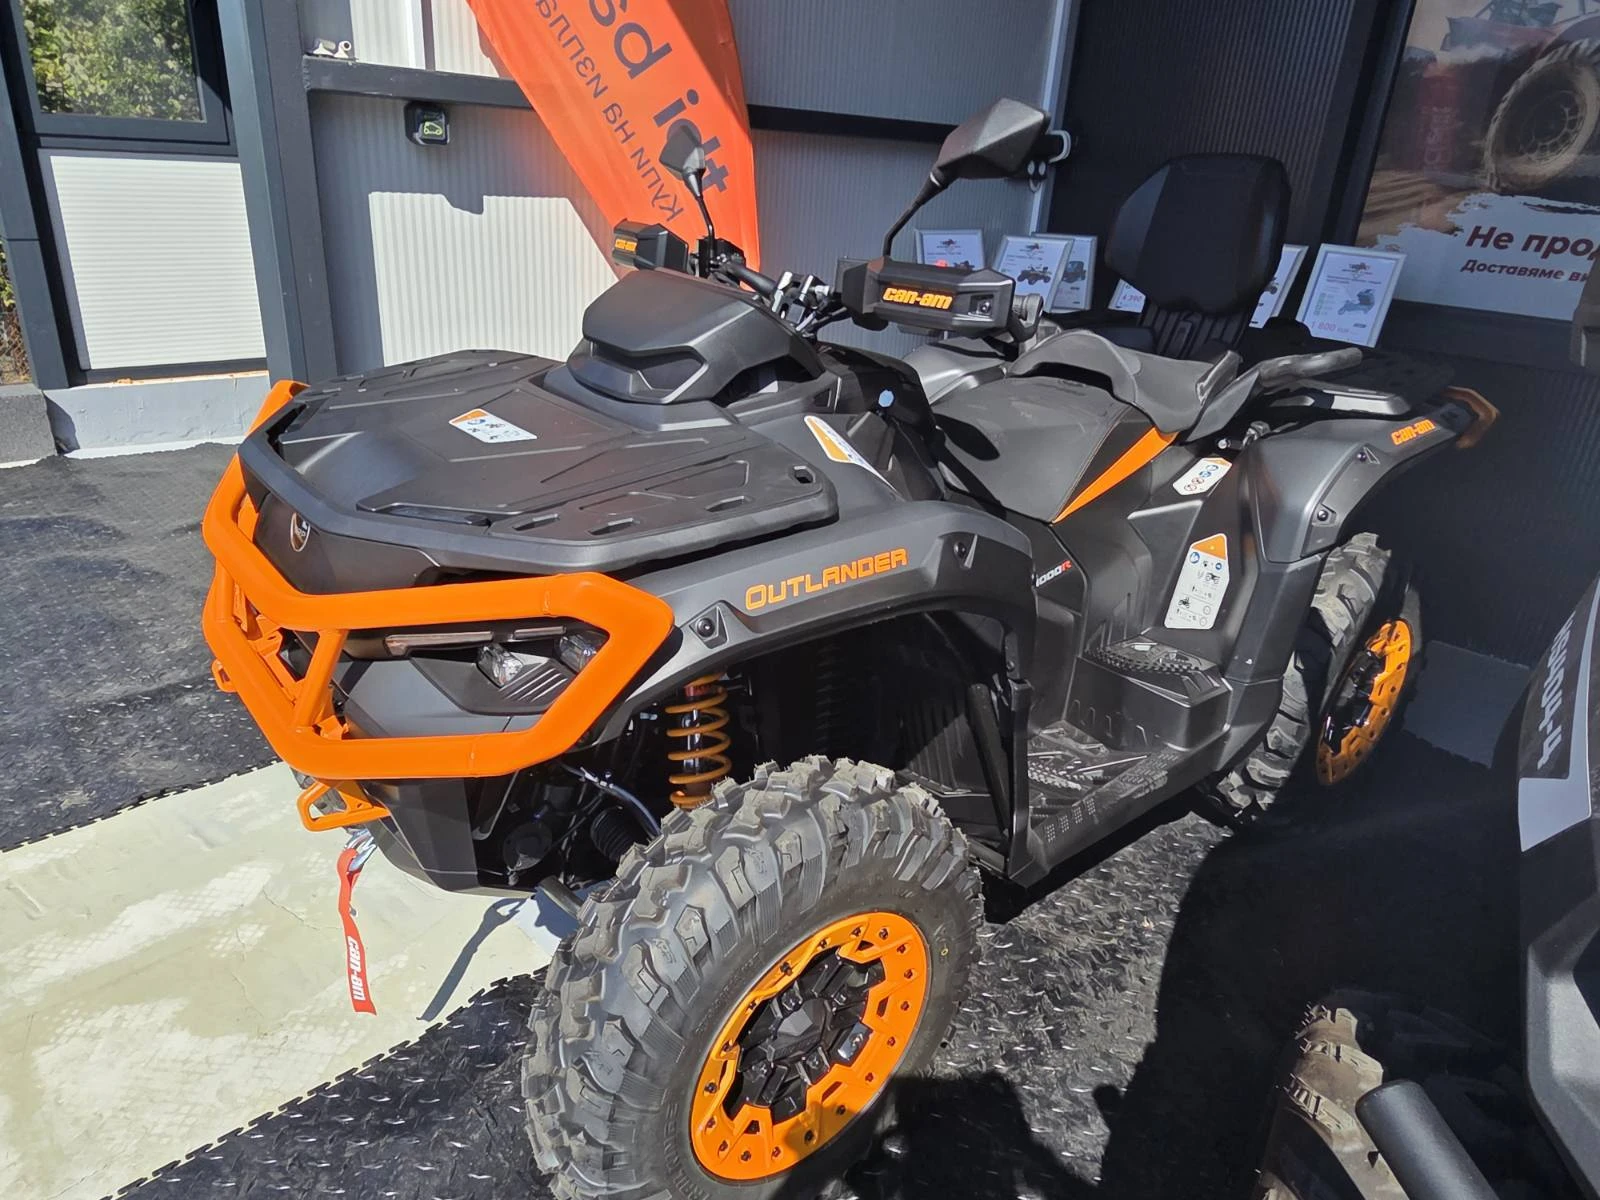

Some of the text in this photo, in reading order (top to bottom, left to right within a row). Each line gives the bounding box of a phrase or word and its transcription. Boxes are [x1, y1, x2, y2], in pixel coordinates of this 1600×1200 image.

[1465, 225, 1515, 250] Не
[1460, 258, 1565, 280] Доставяме
[882, 287, 953, 310] can-am
[1391, 419, 1436, 446] can-am
[745, 548, 908, 611] OUTLANDER
[347, 935, 366, 1001] can-am
